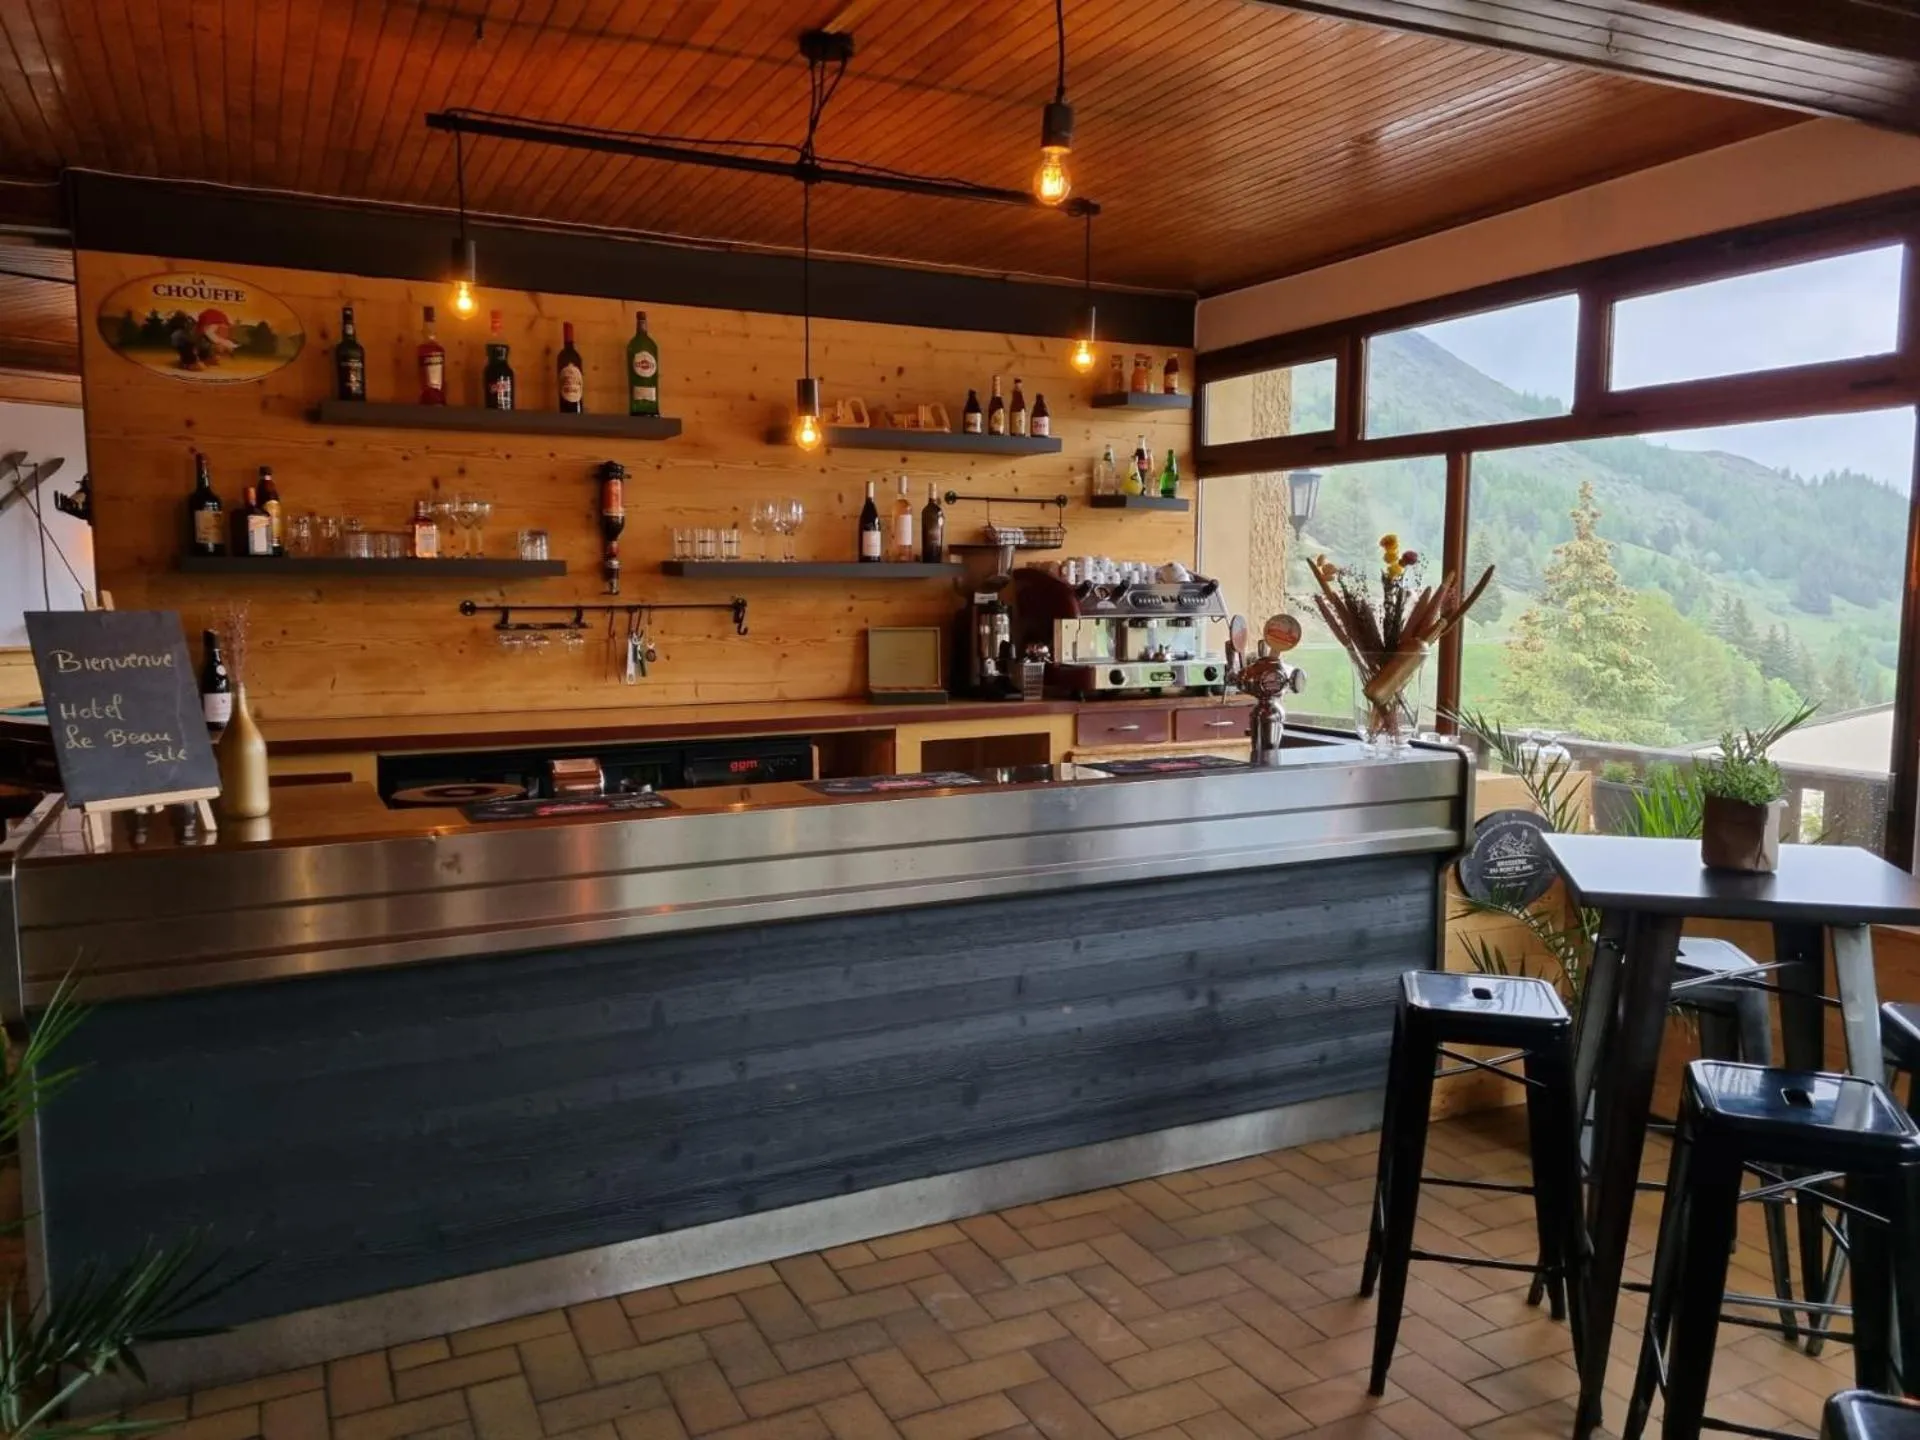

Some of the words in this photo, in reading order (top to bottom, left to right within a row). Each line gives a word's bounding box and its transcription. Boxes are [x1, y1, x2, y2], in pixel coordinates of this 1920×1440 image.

[152, 283, 247, 302] CHOUFFE
[192, 277, 206, 286] LA
[51, 650, 173, 673] Bienvenue
[60, 694, 126, 720] Hotel
[65, 724, 96, 749] Le
[105, 728, 173, 748] Beau
